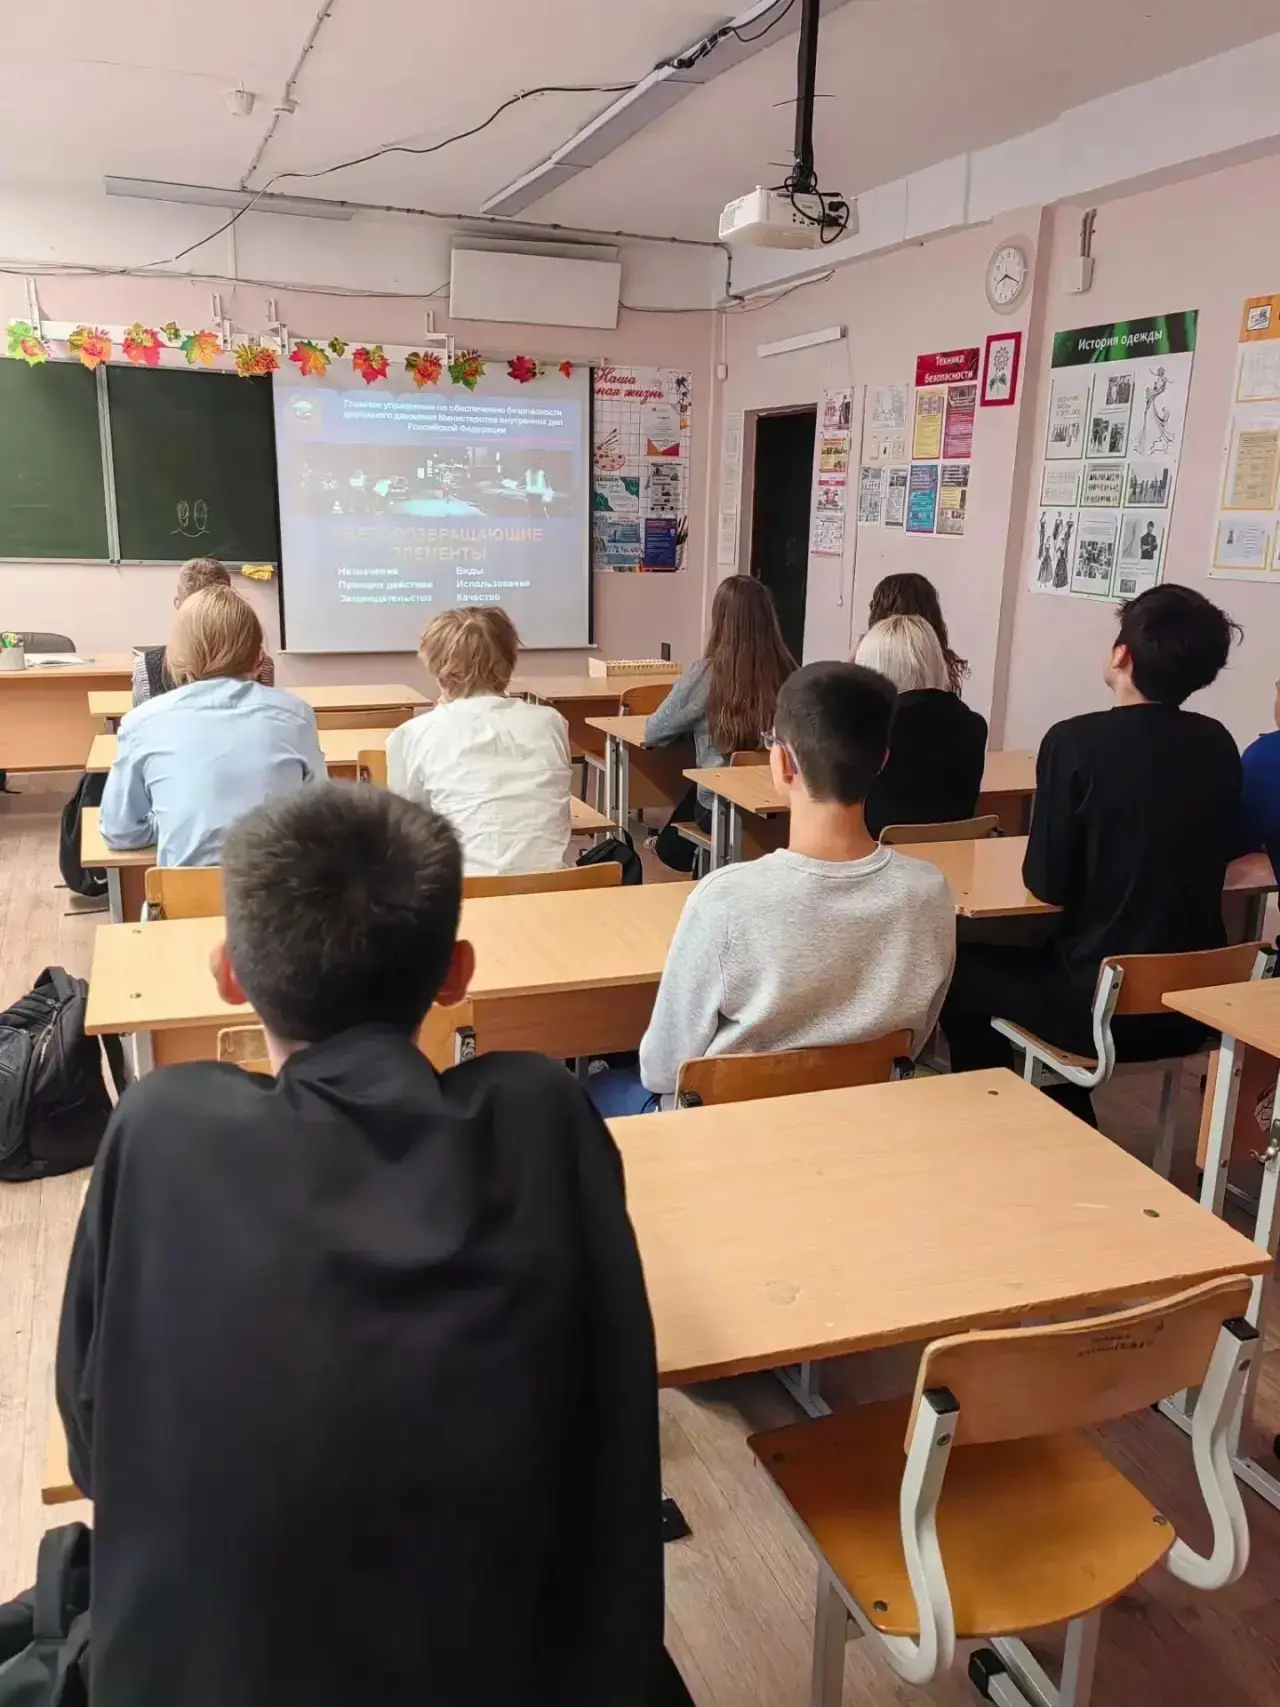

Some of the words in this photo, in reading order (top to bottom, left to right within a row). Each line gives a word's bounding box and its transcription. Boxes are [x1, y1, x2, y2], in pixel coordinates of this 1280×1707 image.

[1078, 336, 1119, 351] История
[1120, 329, 1163, 345] одежды
[935, 354, 965, 367] Техника
[594, 366, 638, 385] Наша
[924, 370, 974, 384] безопасности
[623, 388, 665, 405] жизнь
[456, 565, 484, 577] Виды
[456, 578, 531, 589] Использование
[456, 592, 501, 603] Качество
